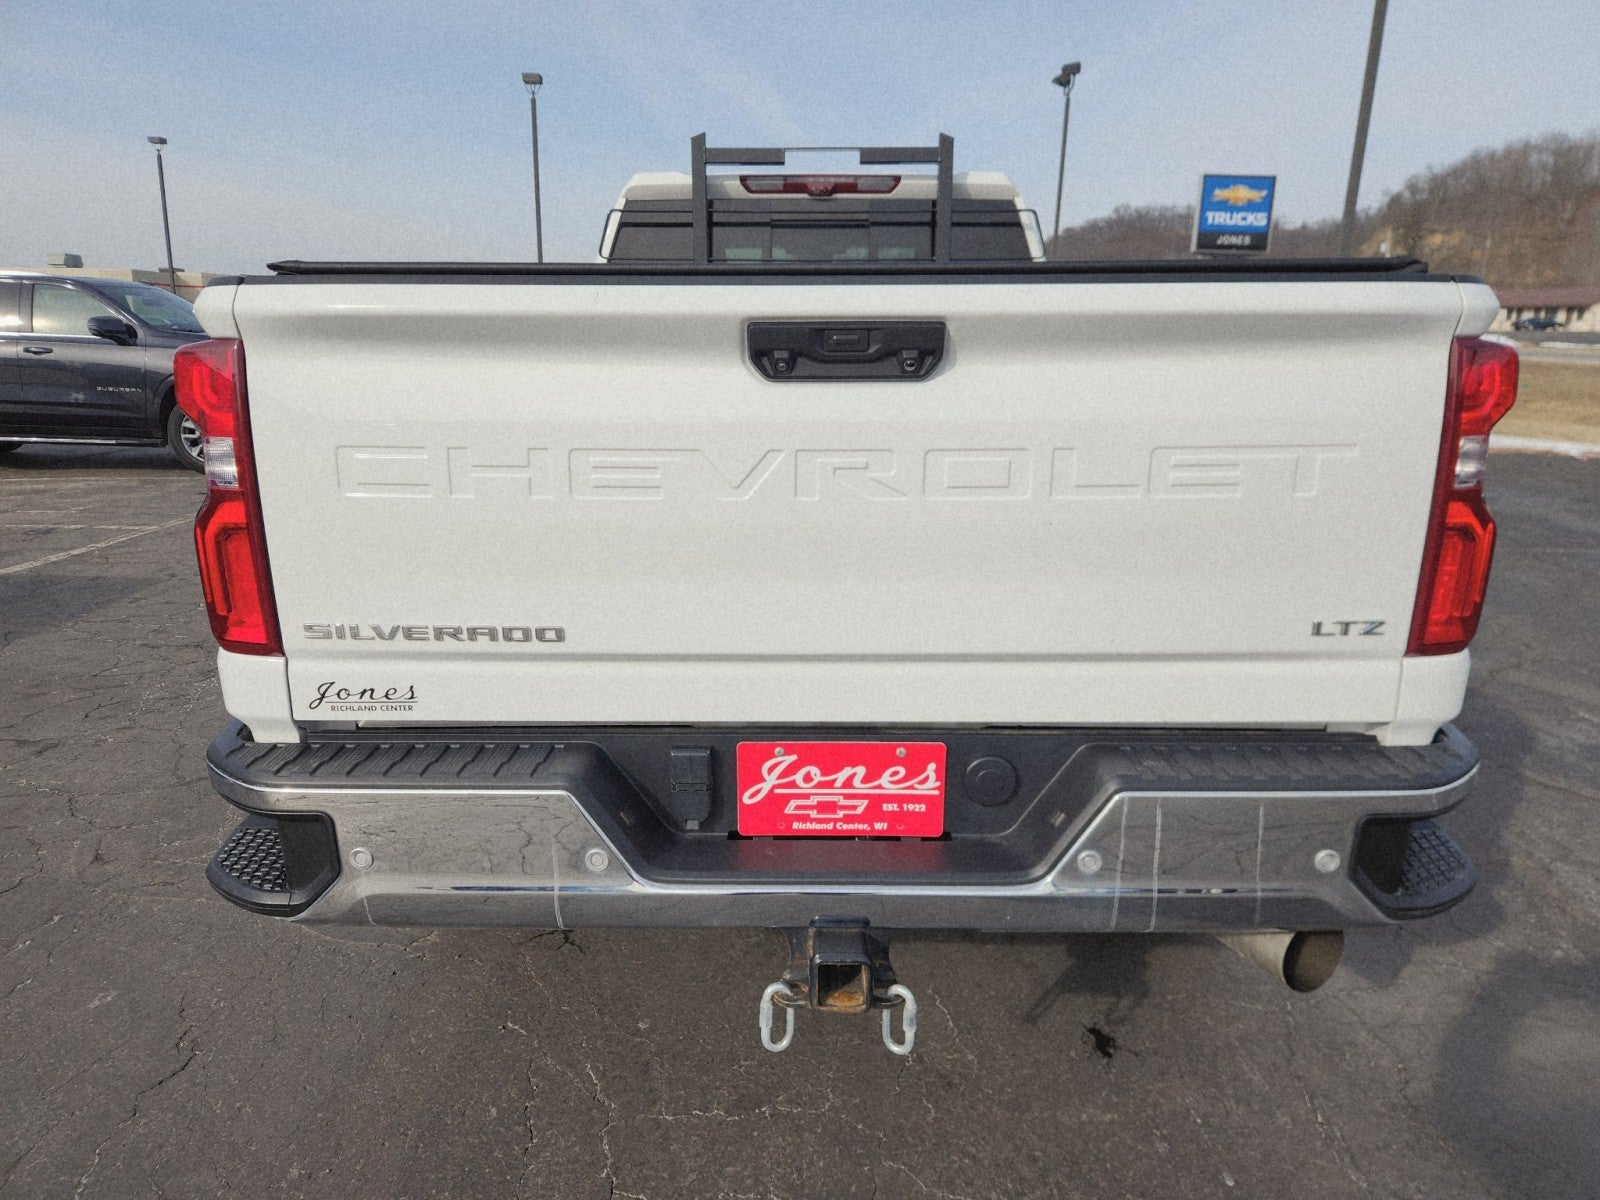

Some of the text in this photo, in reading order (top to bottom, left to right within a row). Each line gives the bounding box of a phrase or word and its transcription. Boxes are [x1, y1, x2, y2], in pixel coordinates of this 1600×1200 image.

[1205, 211, 1268, 226] TRUCKS
[1216, 234, 1251, 246] JONES
[336, 444, 1360, 502] CHEVROLET
[303, 623, 566, 643] SILVERADO
[1311, 620, 1386, 636] LTZ
[309, 681, 418, 710] Jones
[330, 704, 414, 712] RICHLAND CENTER
[742, 754, 941, 805] Jones
[882, 803, 926, 812] EST. 1922
[792, 821, 888, 831] Richland Center, WI
